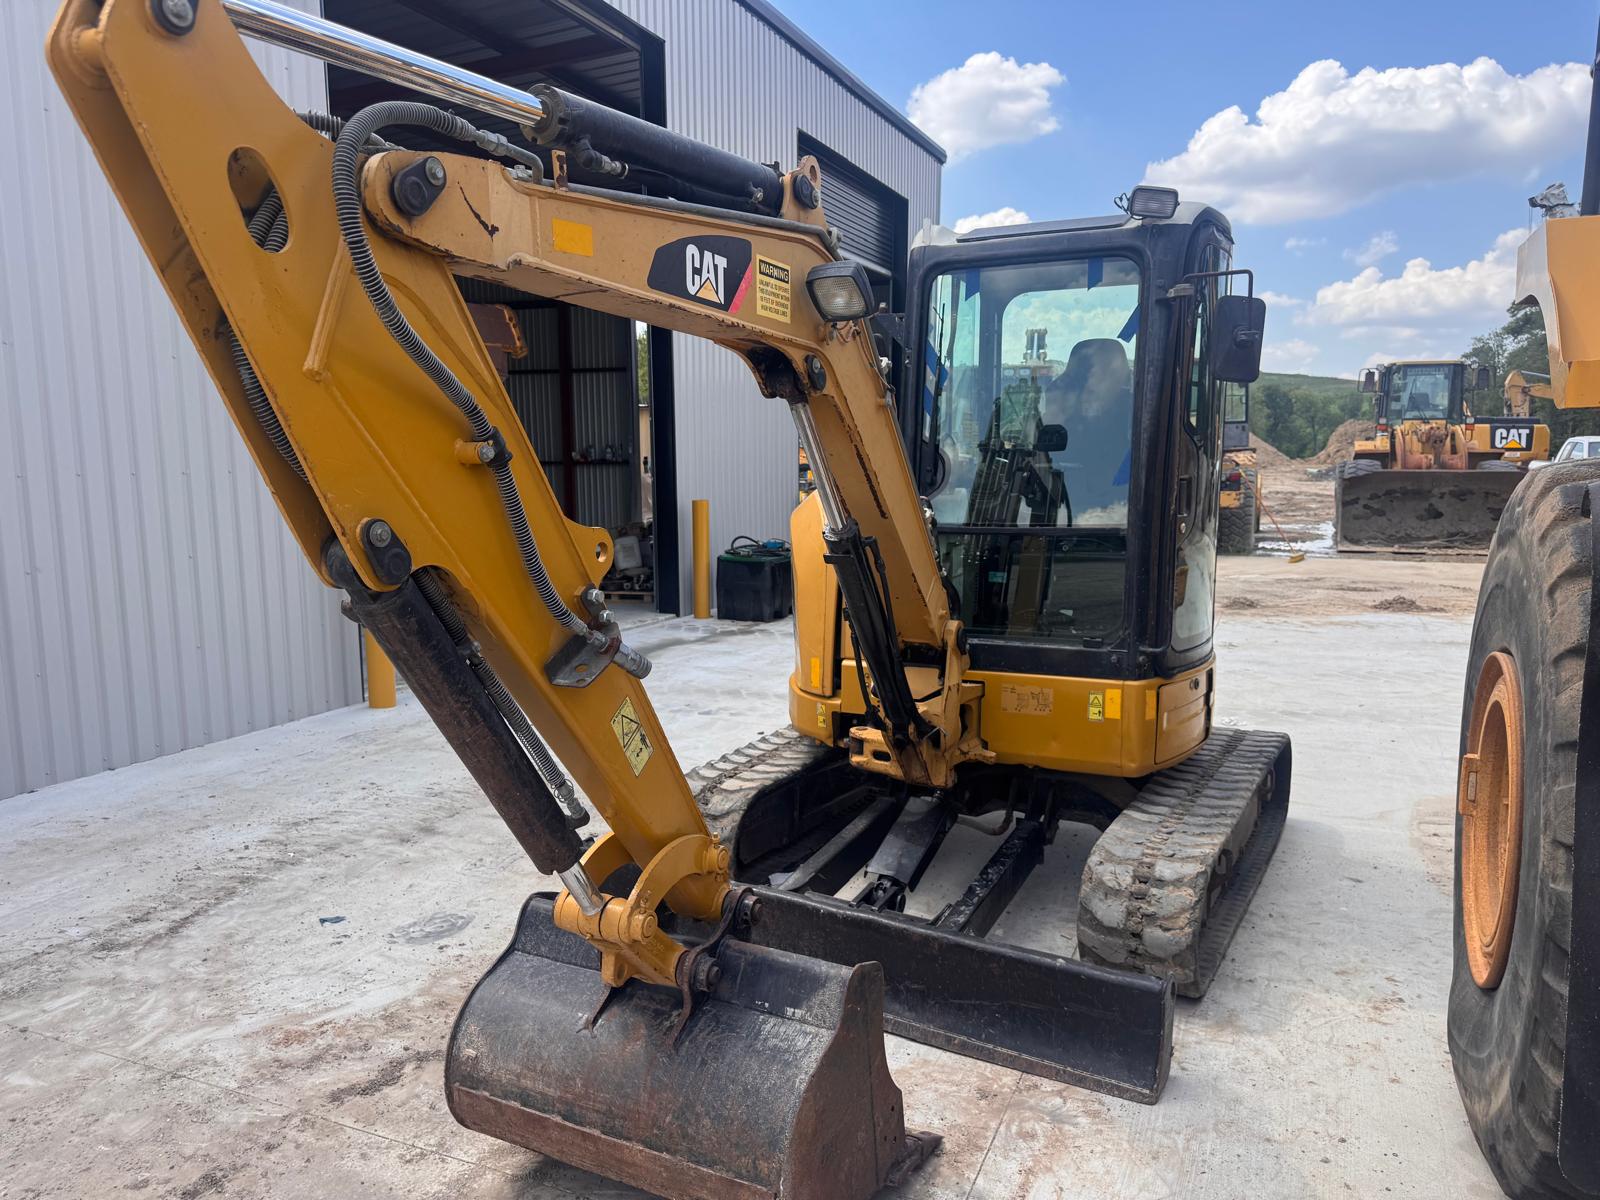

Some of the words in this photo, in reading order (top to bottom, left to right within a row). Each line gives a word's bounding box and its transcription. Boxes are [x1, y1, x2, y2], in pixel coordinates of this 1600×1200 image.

[686, 244, 727, 304] CAT
[760, 261, 789, 281] WARNING
[1495, 428, 1529, 448] CAT
